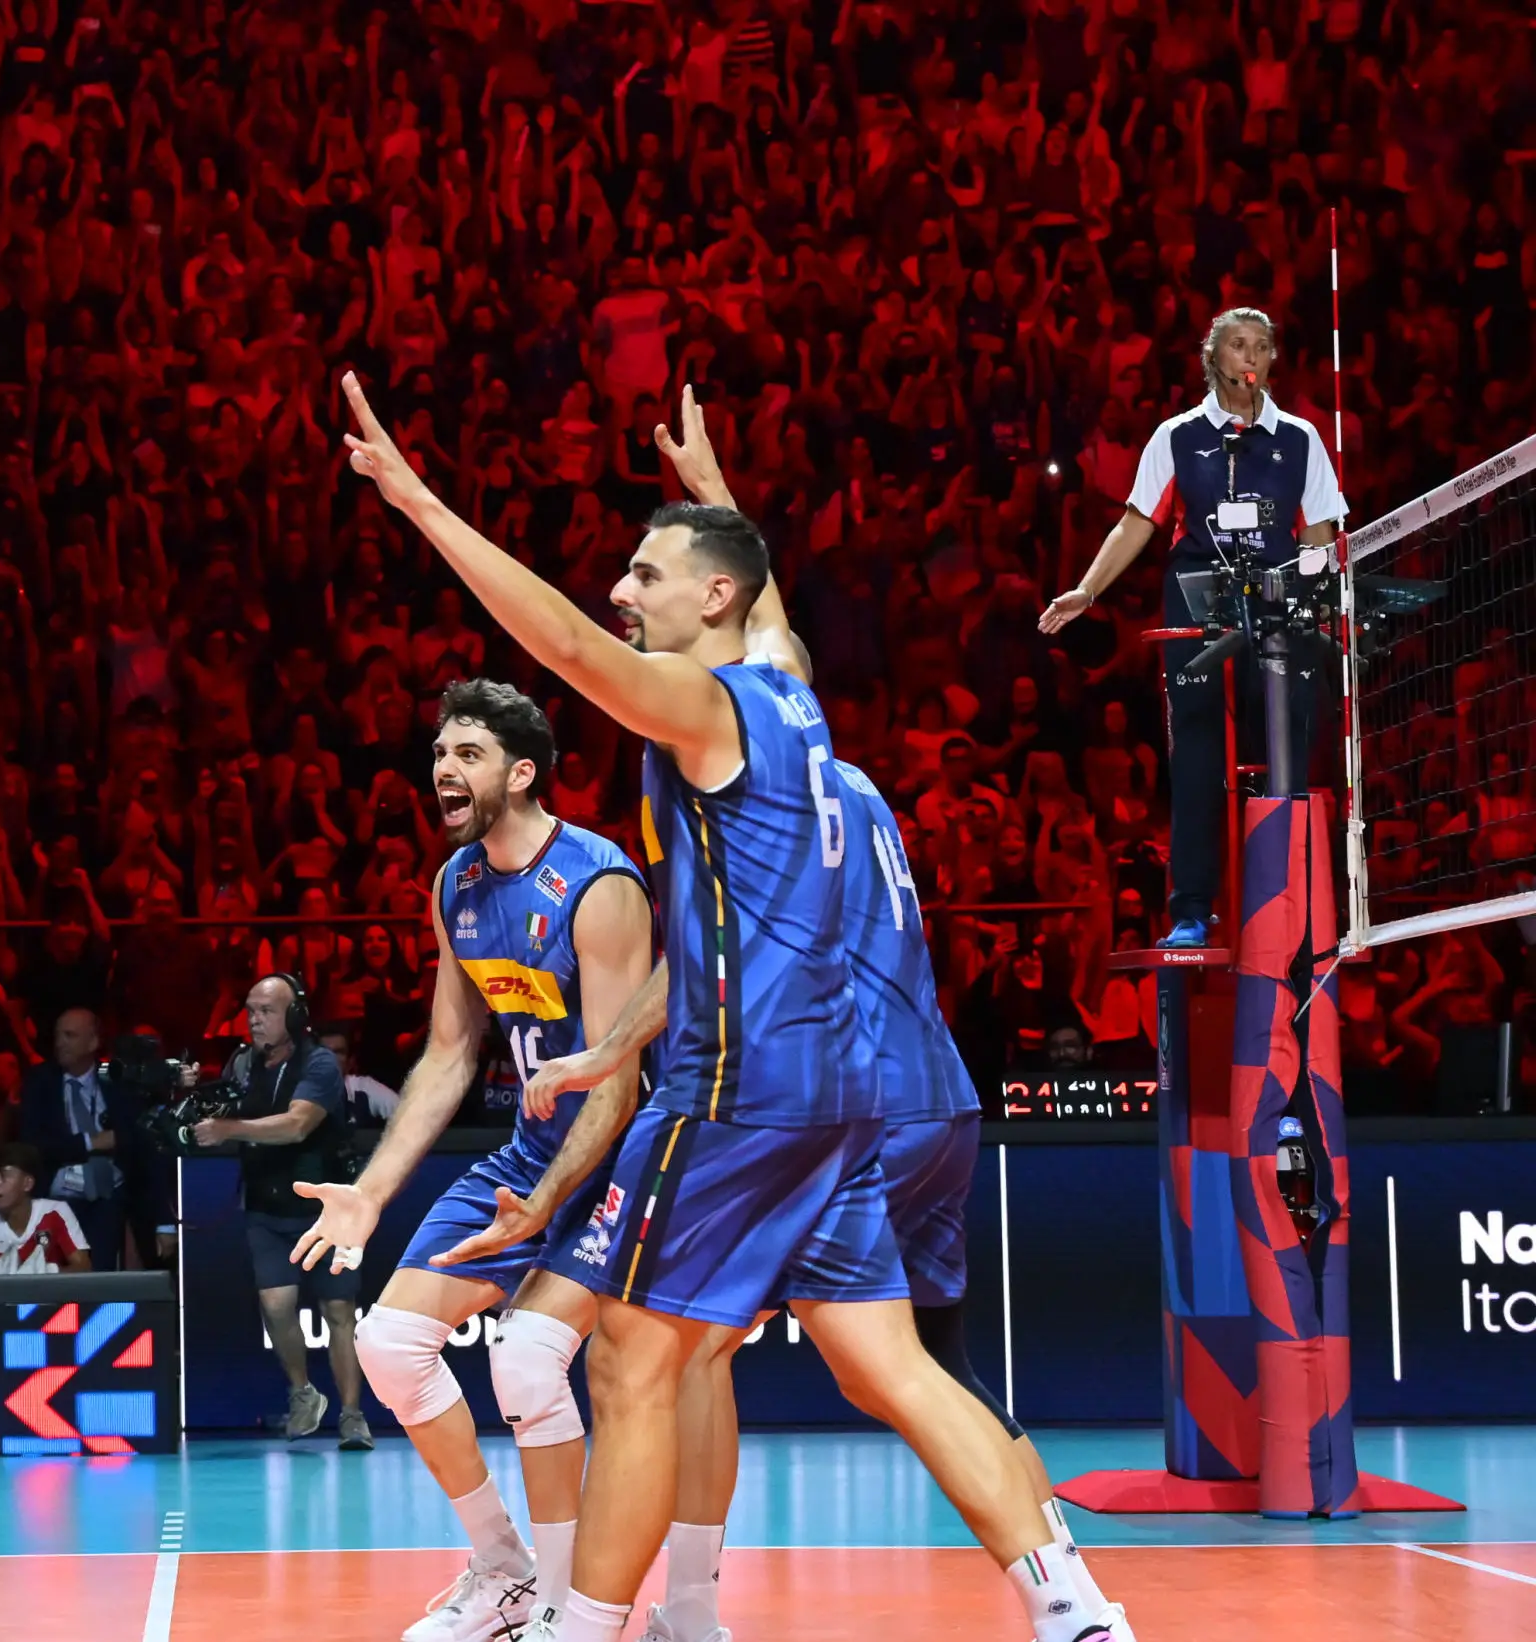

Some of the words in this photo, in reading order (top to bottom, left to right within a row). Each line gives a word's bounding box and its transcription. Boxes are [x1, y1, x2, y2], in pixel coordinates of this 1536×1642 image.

[808, 744, 845, 868] 6
[528, 935, 542, 952] TA
[1172, 953, 1204, 962] Senoh
